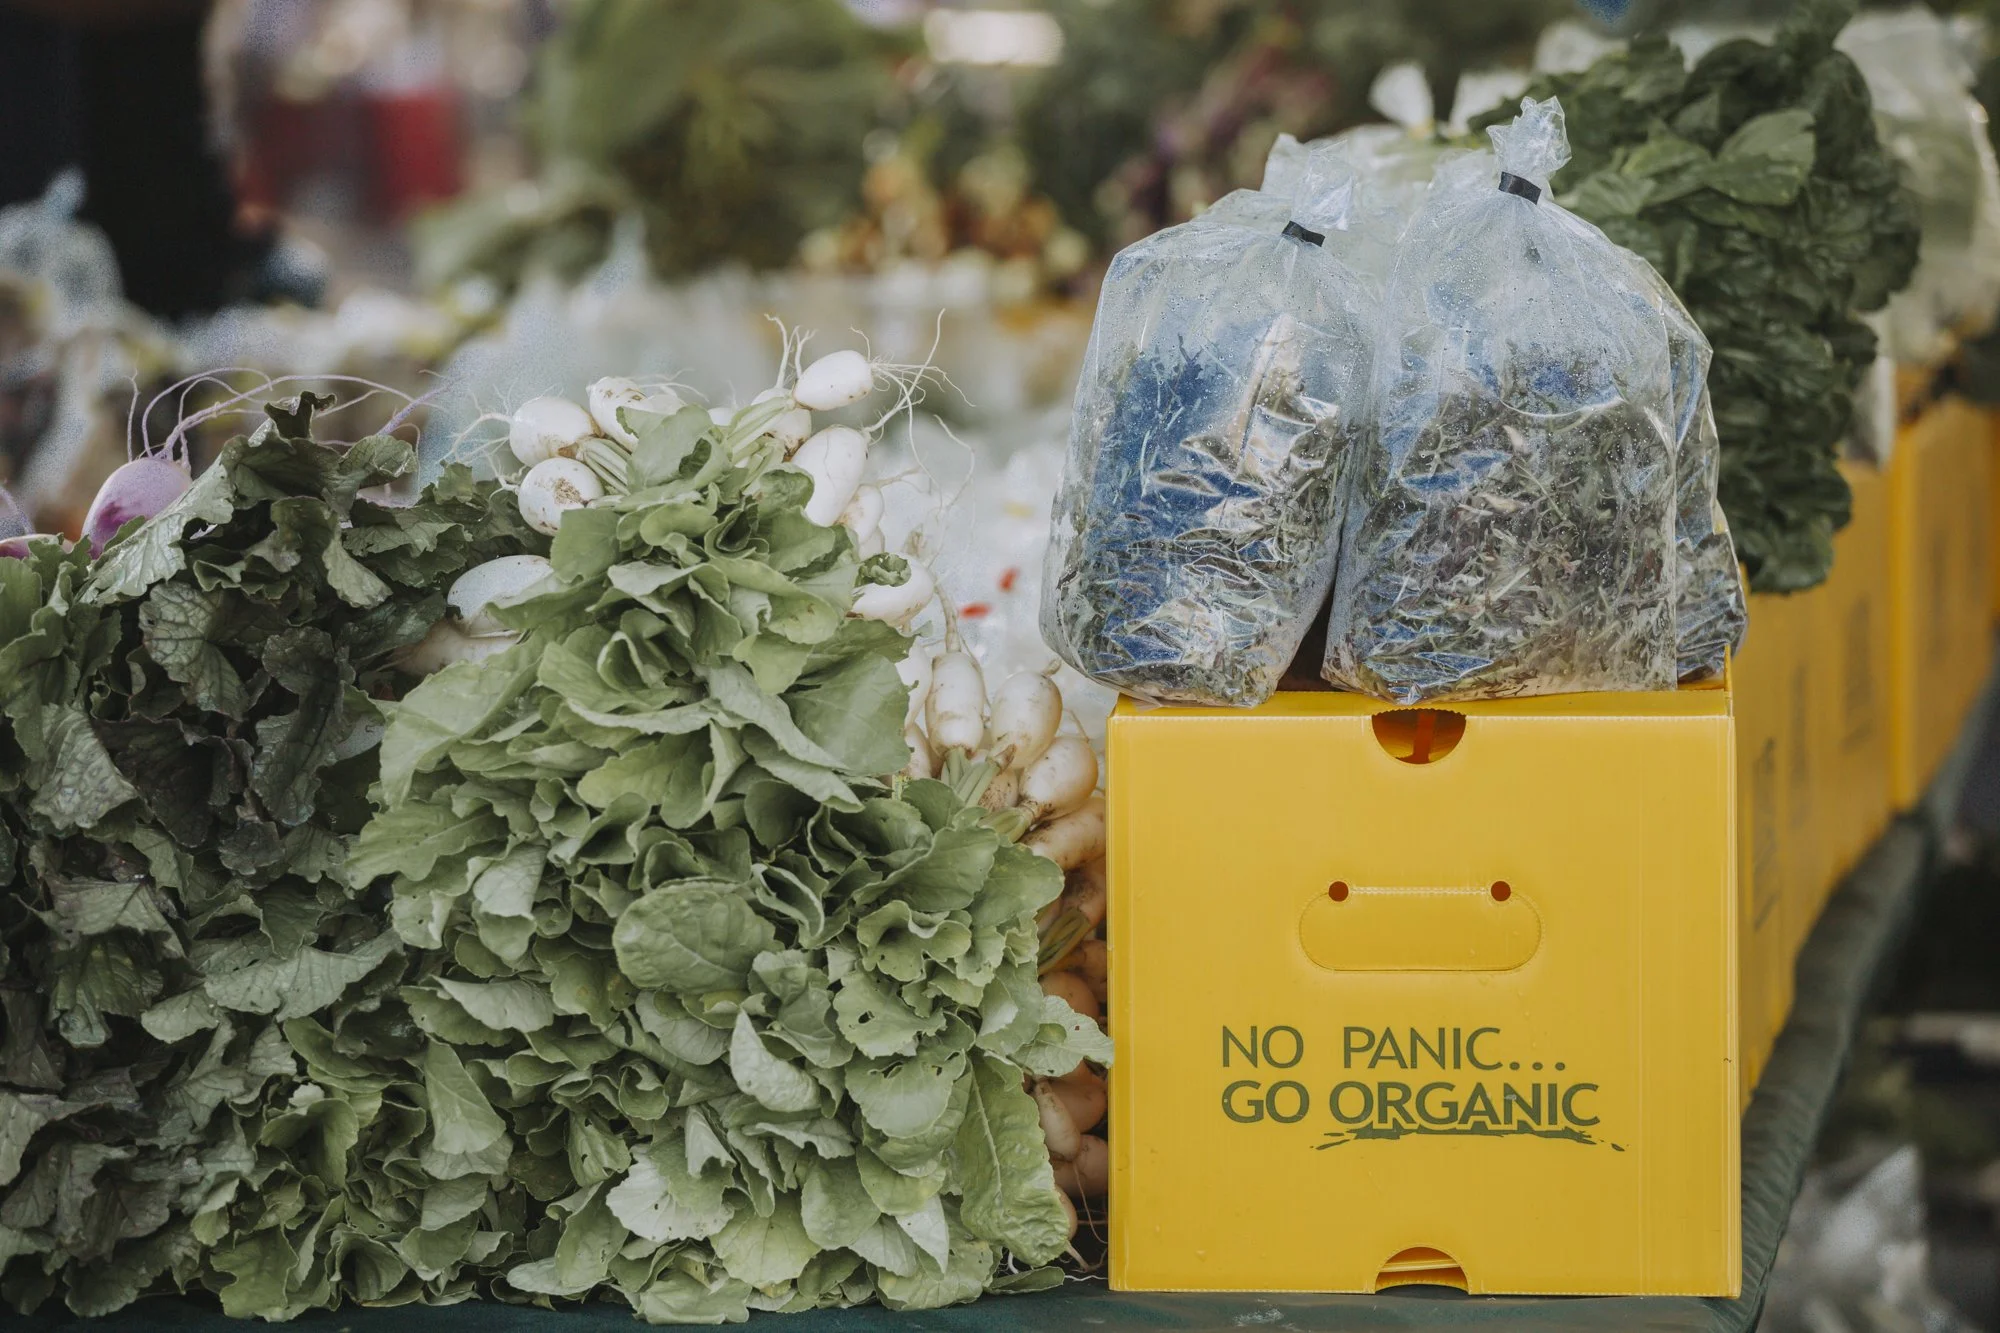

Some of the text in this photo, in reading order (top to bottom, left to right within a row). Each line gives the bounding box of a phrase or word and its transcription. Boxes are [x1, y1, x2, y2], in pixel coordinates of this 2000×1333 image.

[1221, 1025, 1567, 1071] NO PANIC...
[1221, 1080, 1602, 1127] GO ORGANIC
